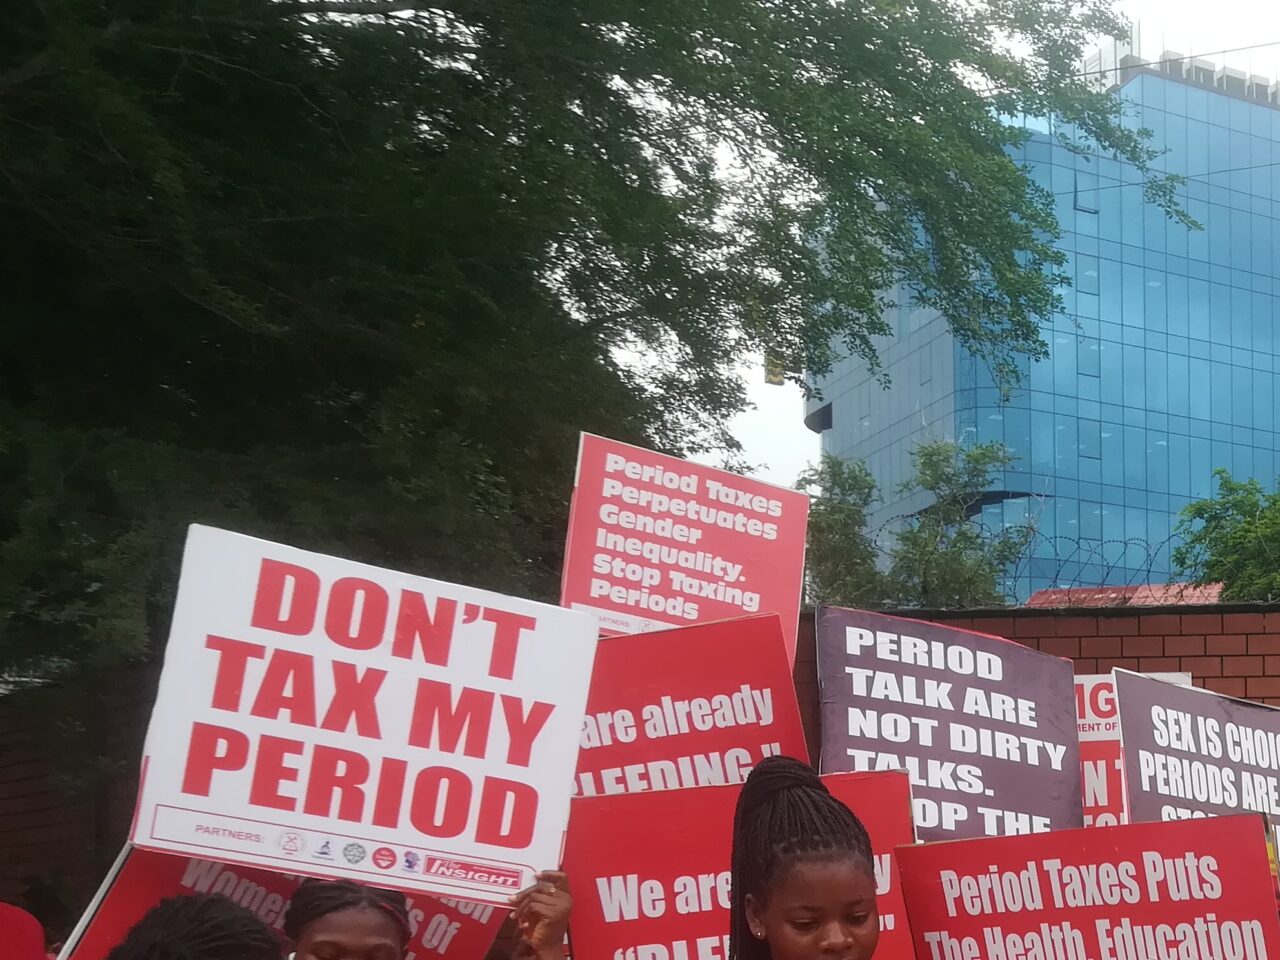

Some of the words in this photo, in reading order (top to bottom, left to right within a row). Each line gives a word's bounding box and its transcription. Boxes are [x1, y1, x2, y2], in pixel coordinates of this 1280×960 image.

[602, 479, 778, 541] Perpetuates
[604, 452, 698, 496] Period
[705, 478, 782, 518] Taxes
[599, 504, 702, 545] Gender
[592, 554, 662, 588] Stop
[668, 570, 760, 611] Taxing
[596, 529, 746, 582] Inequality.
[250, 557, 538, 681] DON'T
[589, 579, 700, 620] Periods
[845, 626, 1003, 681] PERIOD
[204, 635, 388, 741] TAX
[408, 677, 556, 769] MY
[579, 708, 638, 750] are
[642, 684, 774, 739] already
[845, 666, 953, 709] TALK
[963, 684, 1037, 729] ARE
[848, 708, 939, 751] NOT
[950, 723, 1067, 771] DIRTY
[1104, 722, 1118, 731] OF
[1151, 705, 1196, 754] SEX
[1197, 716, 1221, 759] IS
[181, 721, 540, 851] PERIOD
[847, 748, 995, 796] TALKS.
[1139, 750, 1238, 809] PERIODS
[1241, 772, 1280, 816] ARE
[195, 824, 265, 844] PARTNERS:
[978, 808, 1051, 836] THE
[430, 859, 519, 886] INSIGHT
[596, 874, 666, 923] We
[940, 860, 1042, 918] Period
[1043, 855, 1140, 909] Taxes
[1142, 851, 1223, 900] Puts
[421, 913, 462, 955] Of
